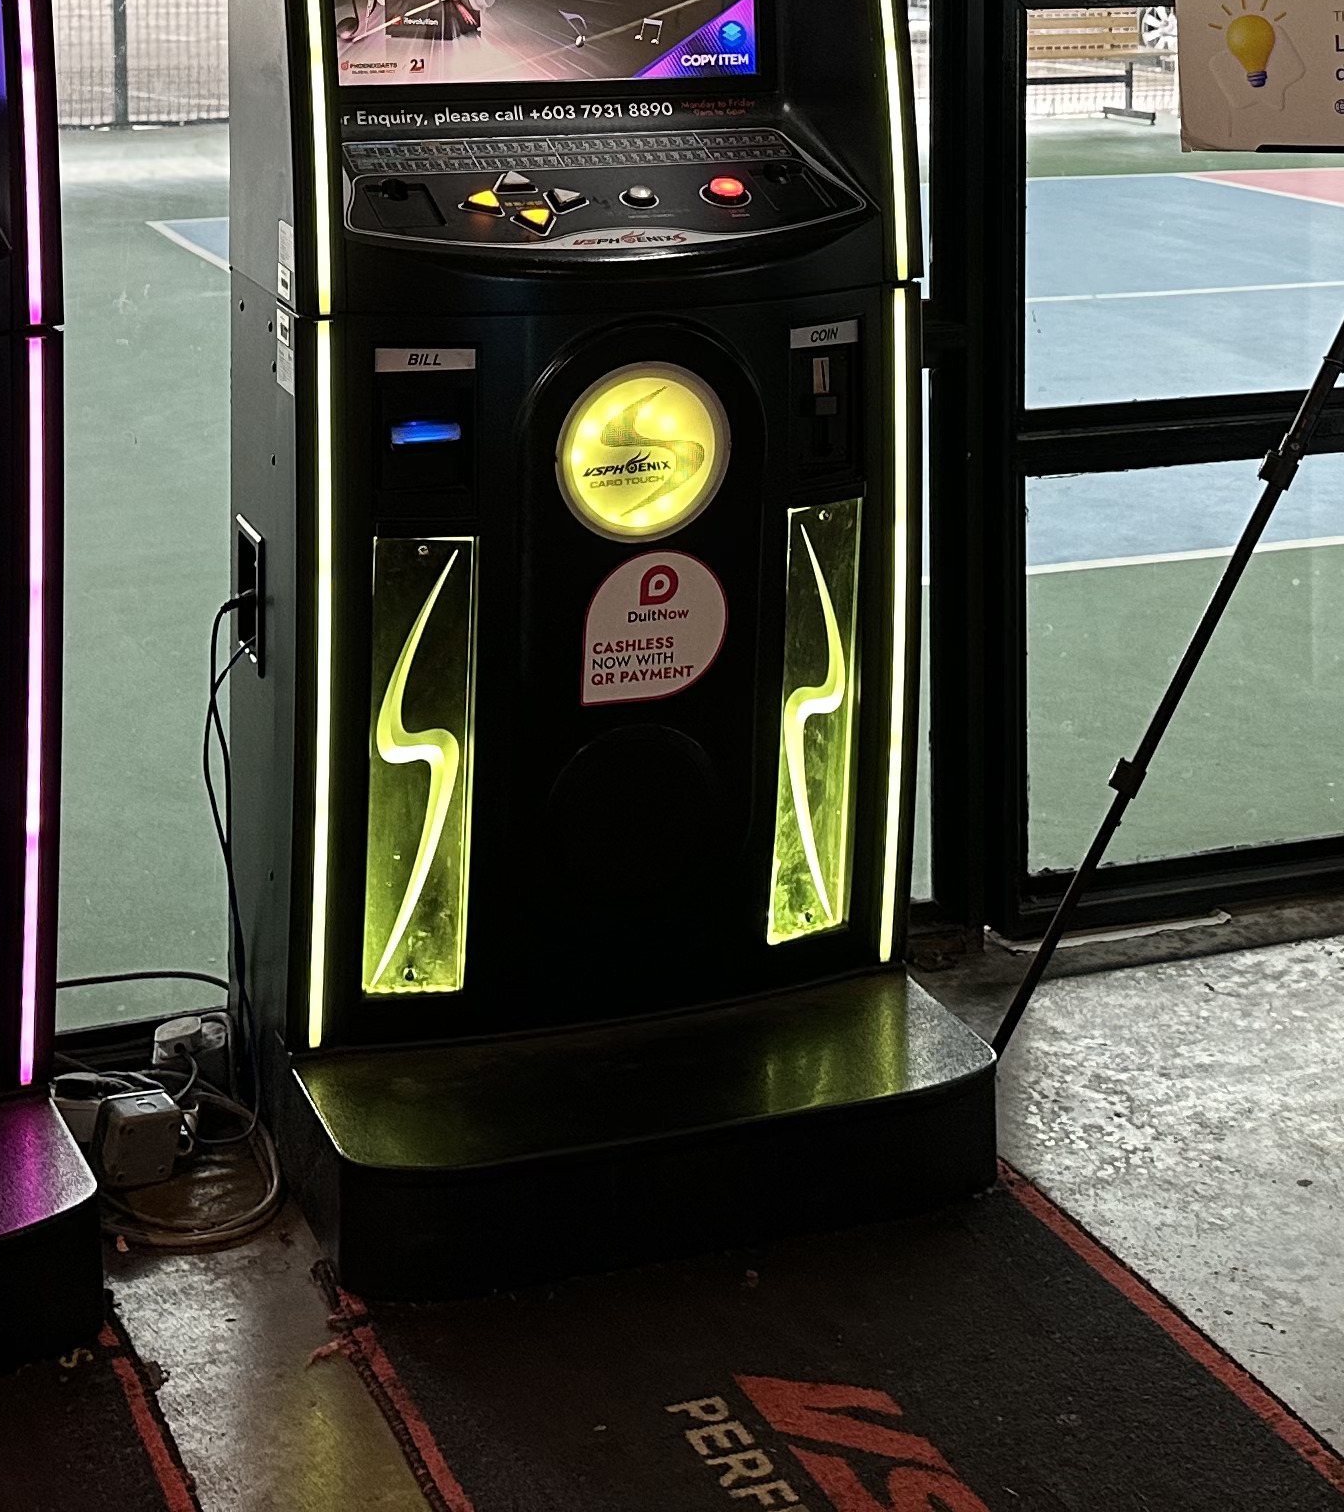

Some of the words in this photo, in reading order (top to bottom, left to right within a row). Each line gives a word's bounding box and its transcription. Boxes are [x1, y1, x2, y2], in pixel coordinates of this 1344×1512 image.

[810, 327, 838, 344] COIN
[407, 354, 442, 367] BILL
[590, 478, 623, 490] CARD
[625, 475, 665, 487] TOUCH
